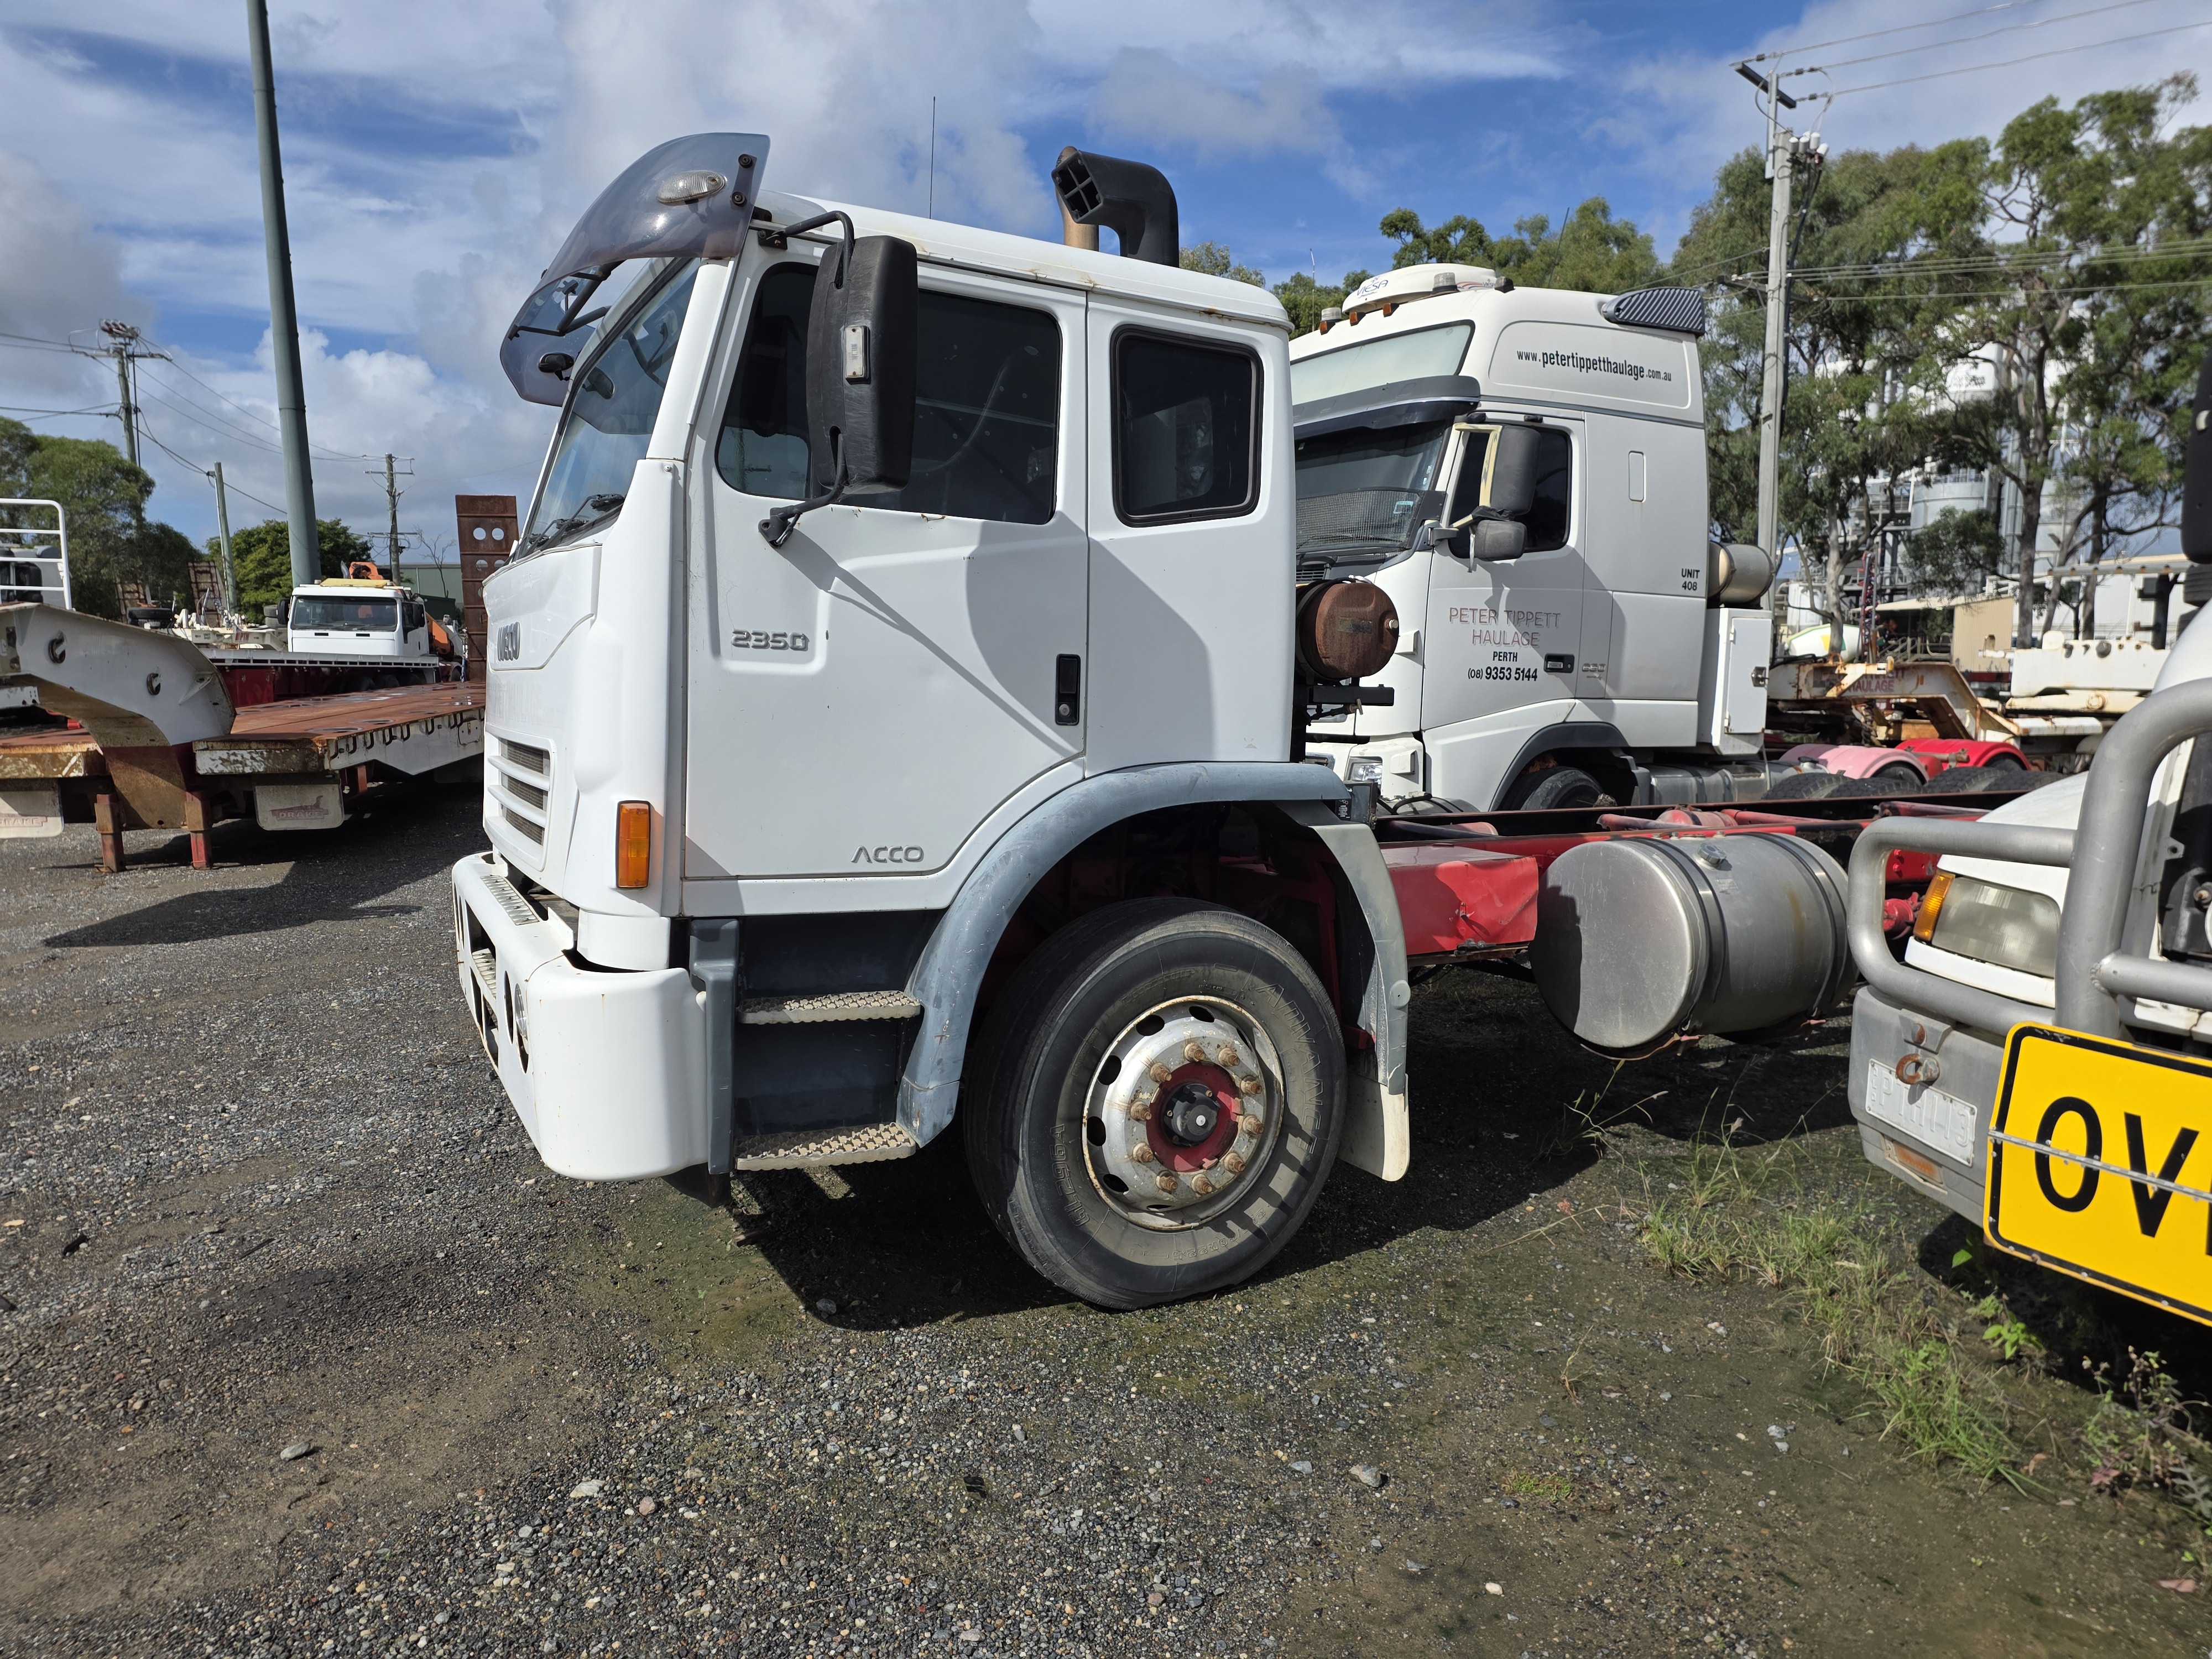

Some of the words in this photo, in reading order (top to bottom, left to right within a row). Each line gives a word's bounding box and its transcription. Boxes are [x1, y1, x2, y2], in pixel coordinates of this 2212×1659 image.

[1357, 279, 1389, 296] VIESA
[1681, 568, 1700, 579] UNIT
[1682, 581, 1698, 591] 408
[1449, 607, 1499, 625] PETER
[1504, 609, 1561, 628] TIPPETT
[731, 629, 809, 651] 2350
[1472, 629, 1540, 648] HAULAGE
[1493, 651, 1518, 662] PERTH
[1468, 667, 1483, 680] (08)
[1485, 666, 1512, 681] 9353
[1514, 667, 1538, 681] 5144
[0, 817, 41, 827] RAKE
[851, 844, 924, 864] ACCO
[1255, 983, 1324, 1154] ADVANCE
[1050, 1123, 1090, 1227] GL296A
[2034, 1095, 2212, 1257] OV
